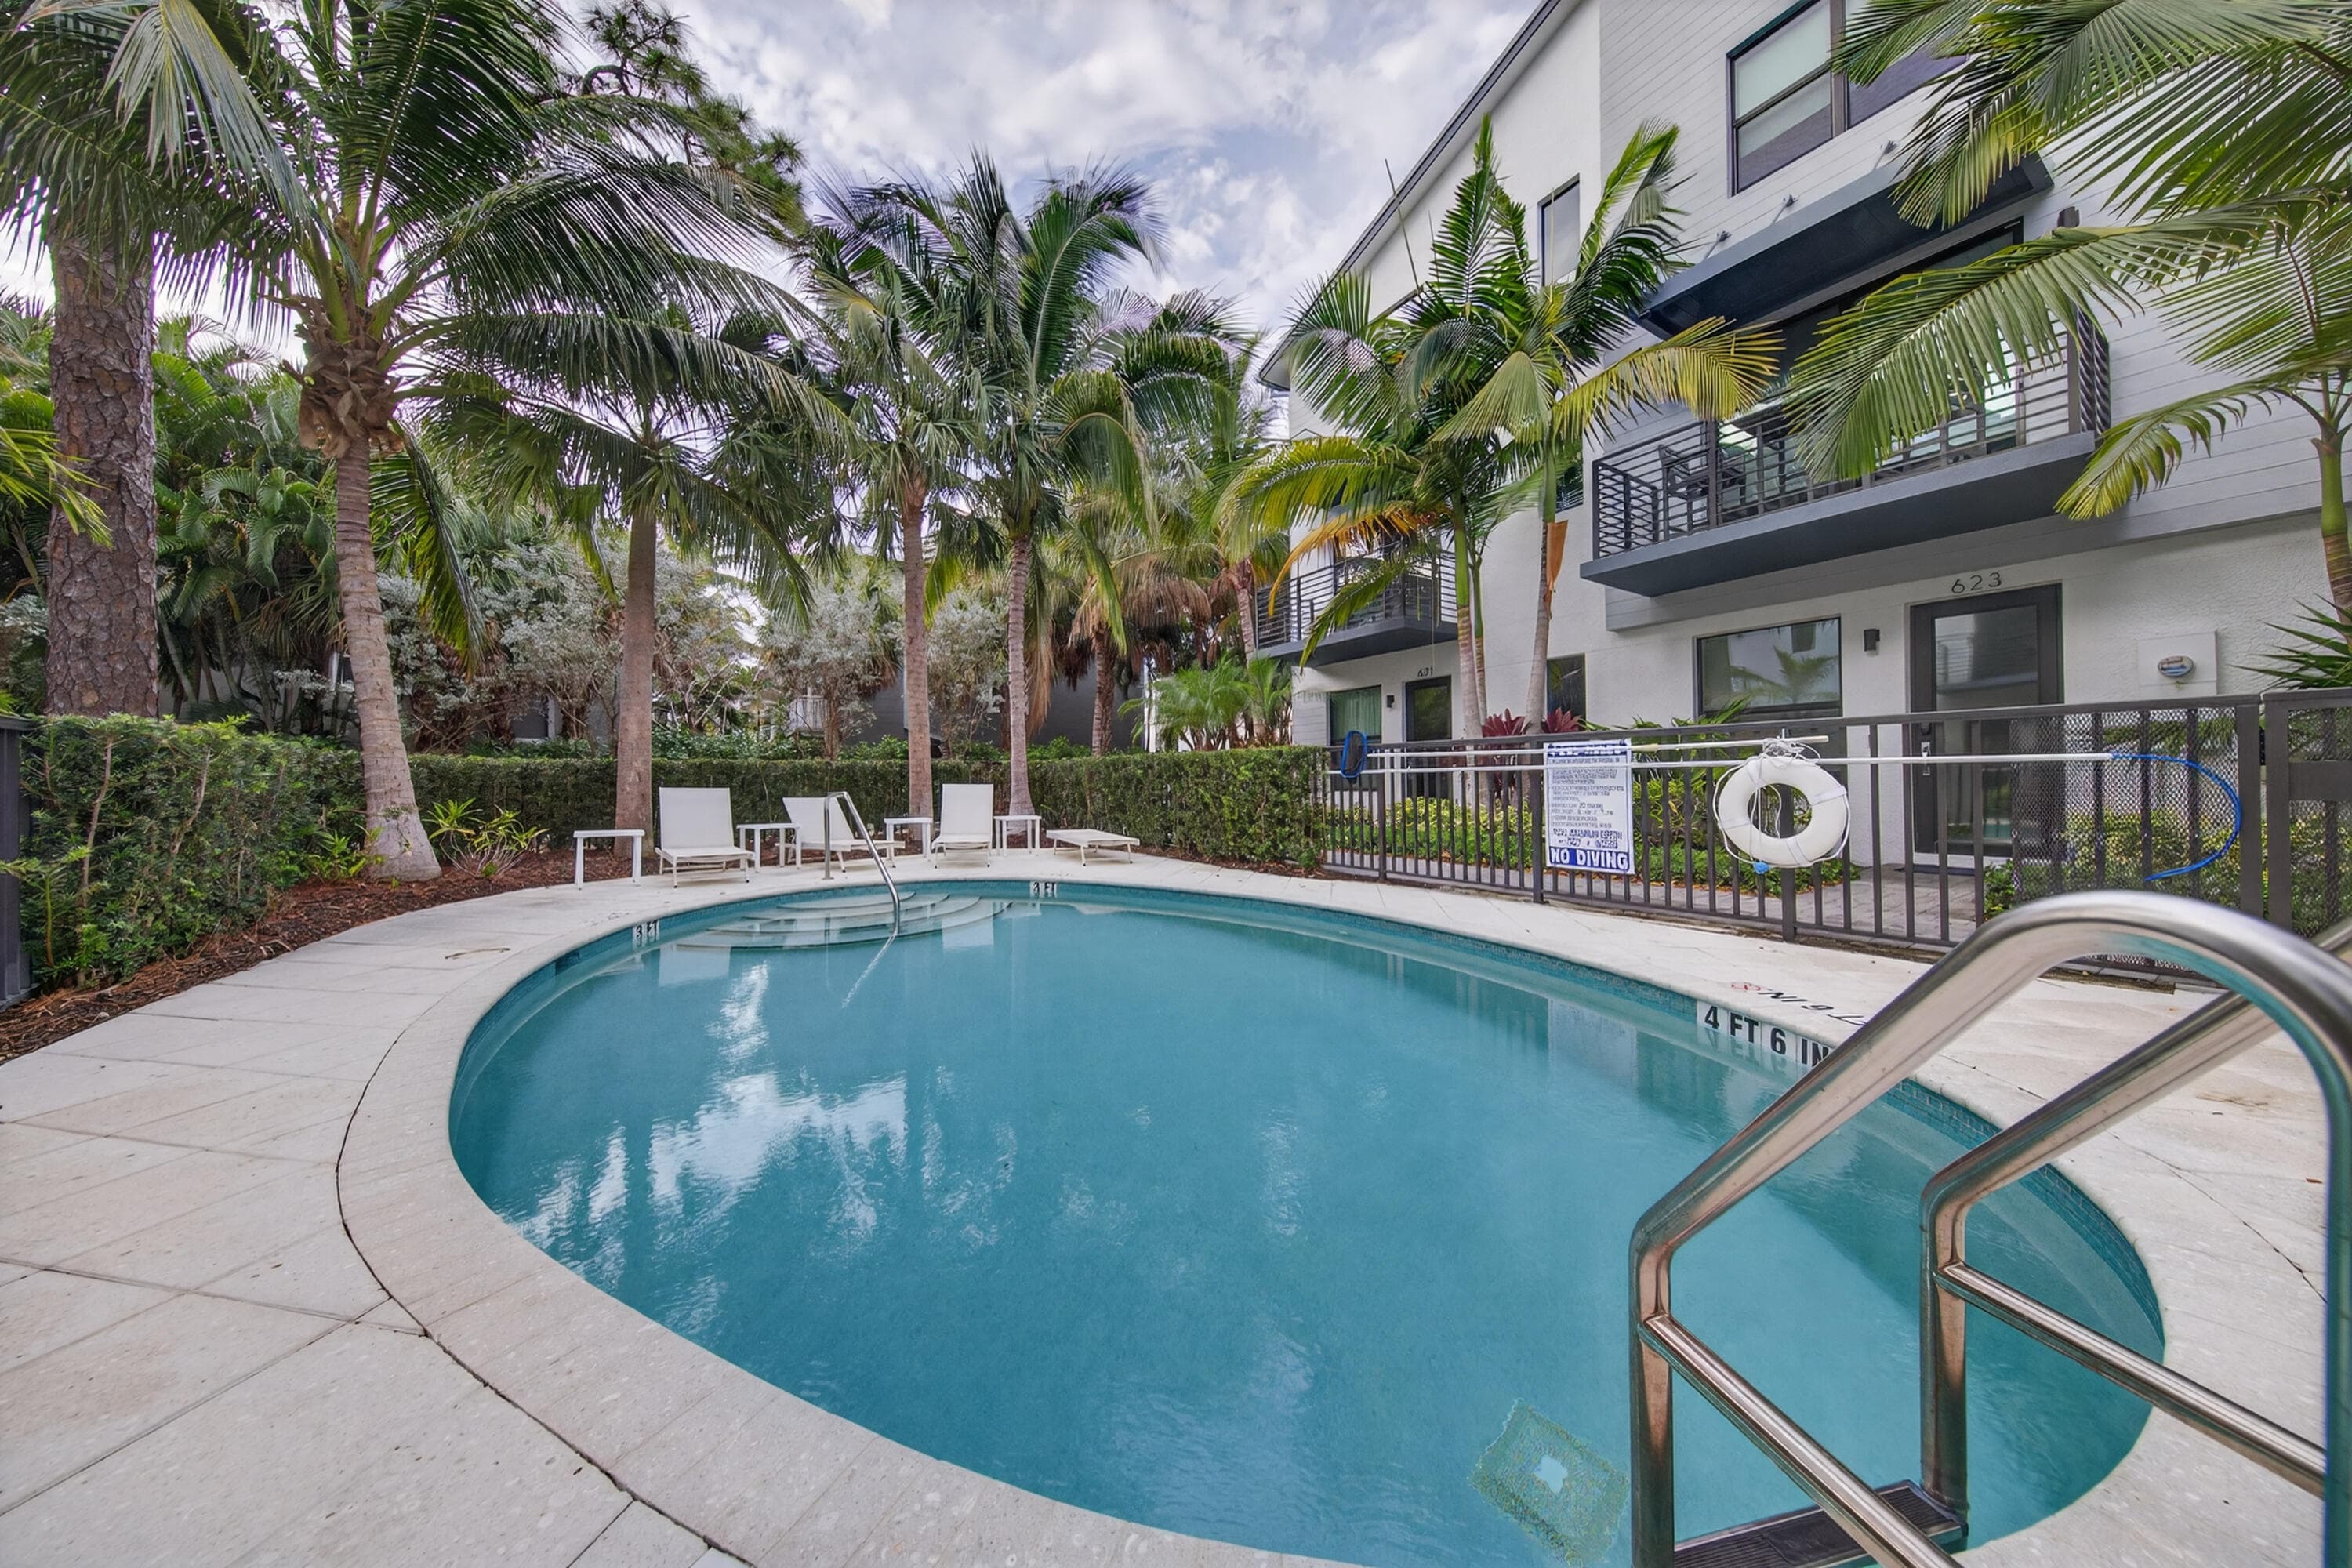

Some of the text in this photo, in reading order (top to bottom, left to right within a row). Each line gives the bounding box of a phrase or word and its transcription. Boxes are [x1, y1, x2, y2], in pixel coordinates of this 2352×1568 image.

[1951, 572, 2002, 594] 623
[1550, 847, 1628, 869] NO DIVING
[1704, 1006, 1830, 1067] 4 FT 6 IN
